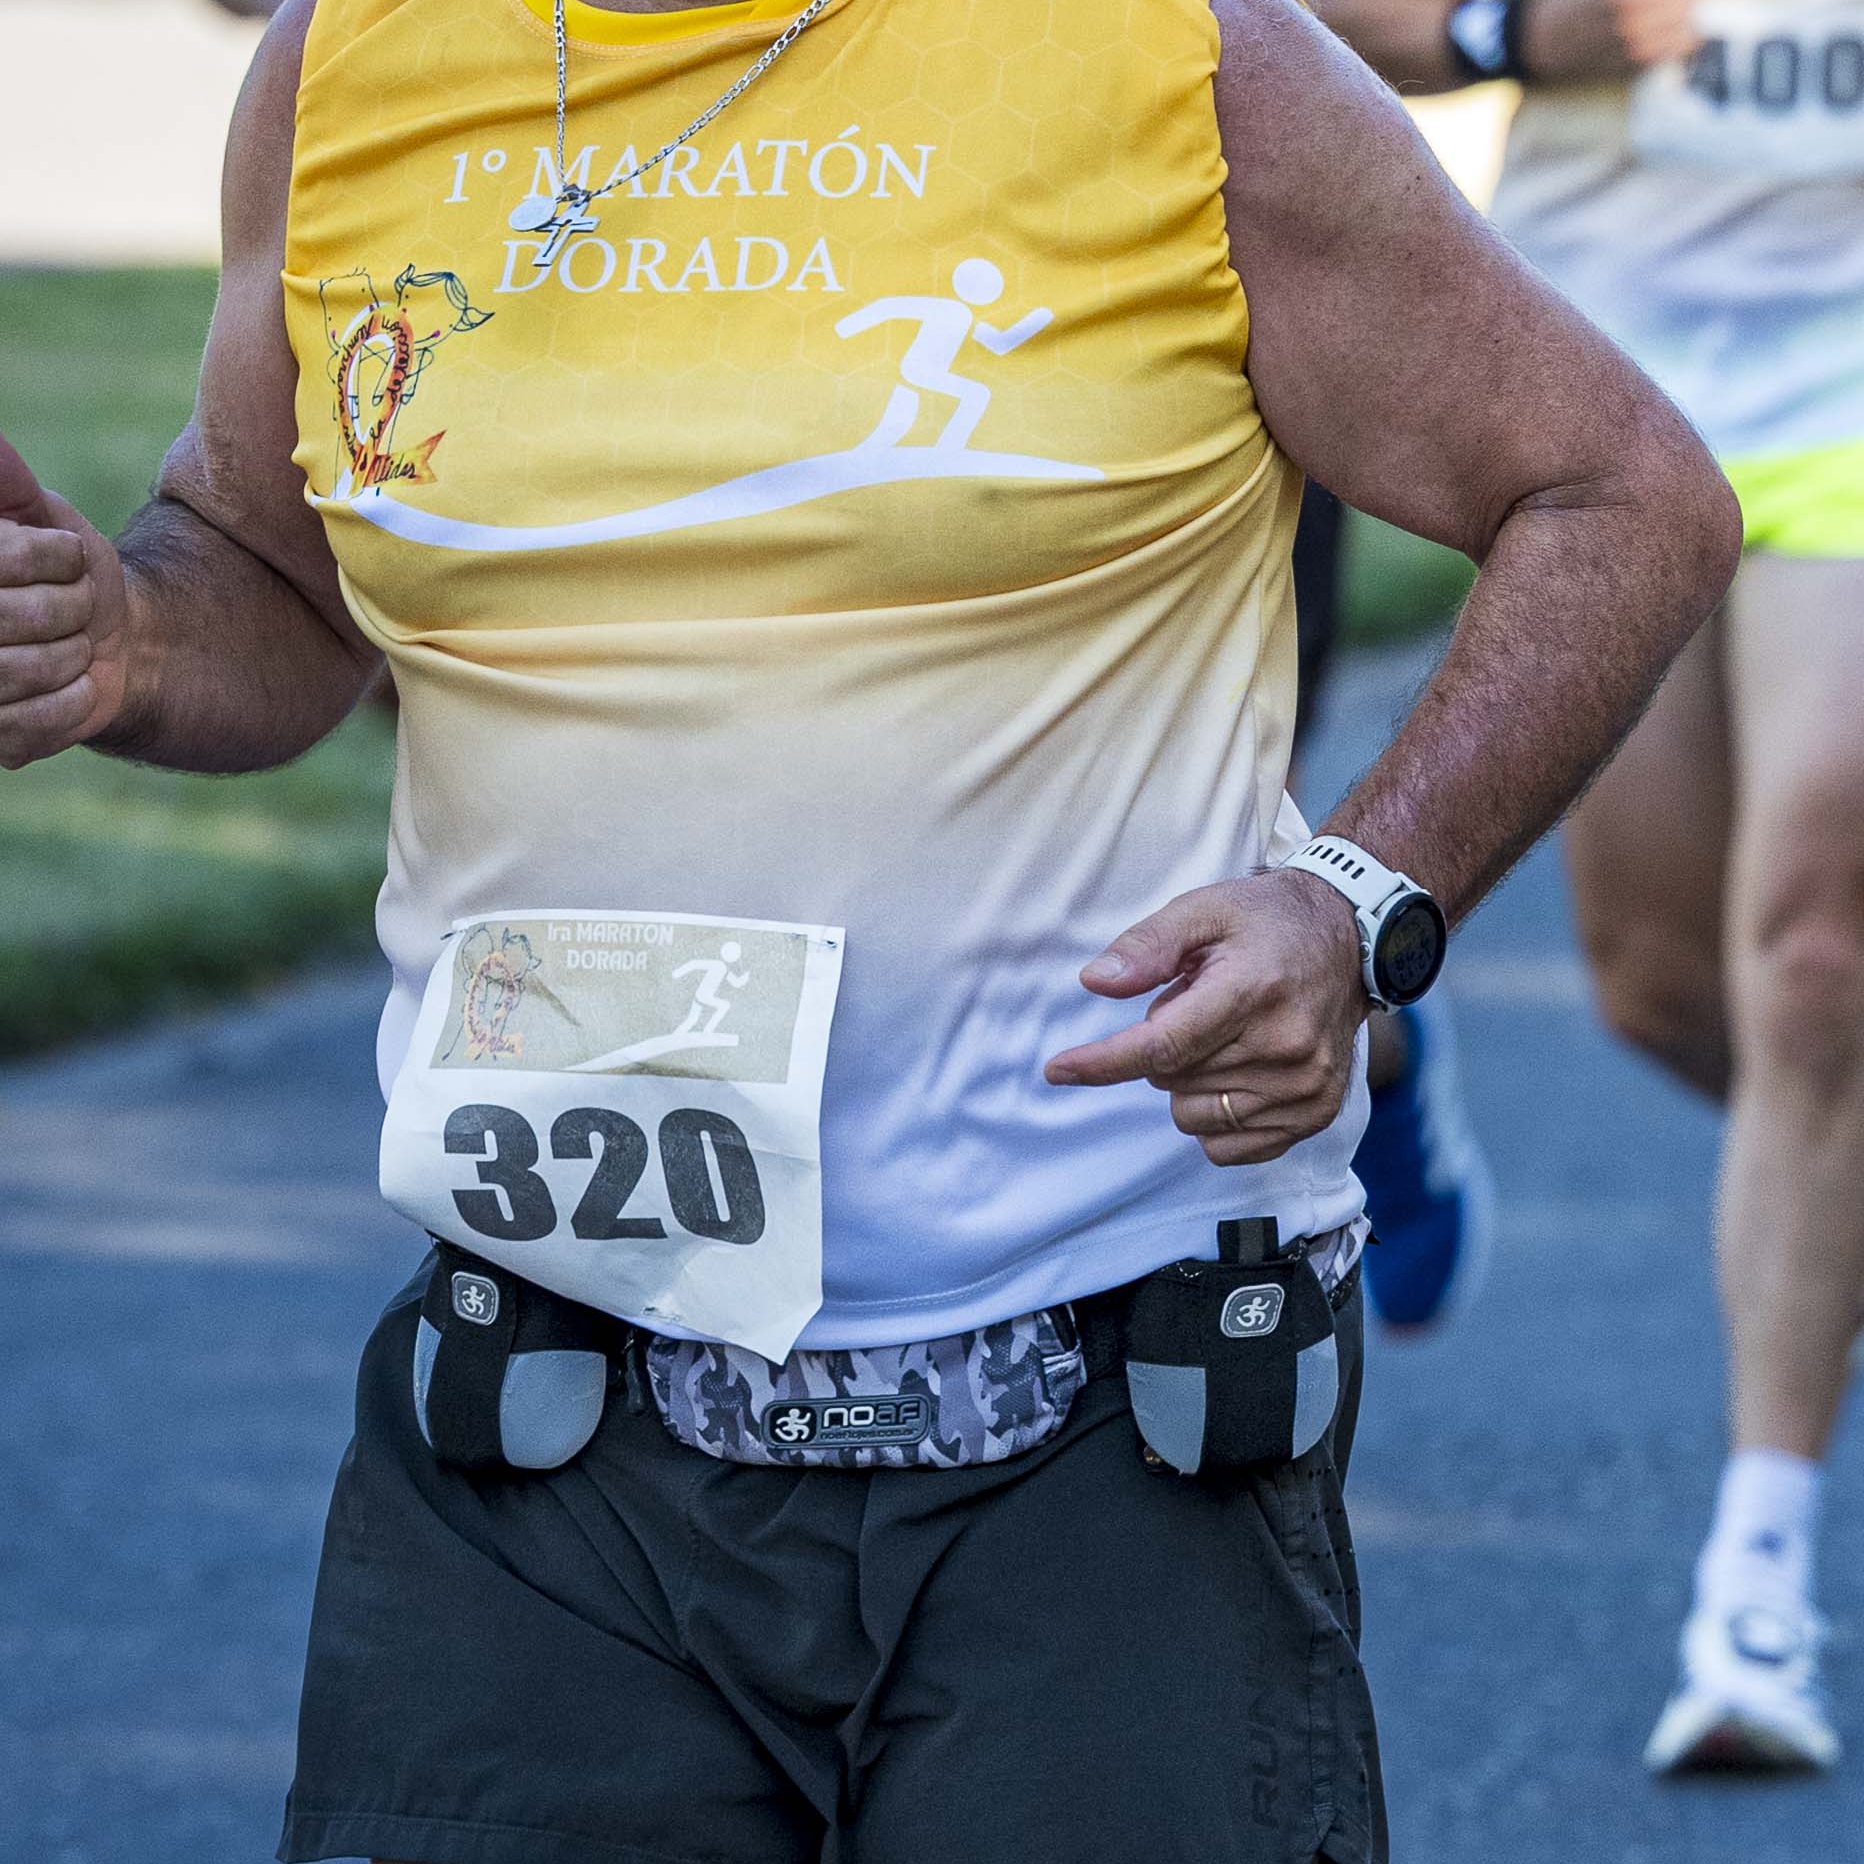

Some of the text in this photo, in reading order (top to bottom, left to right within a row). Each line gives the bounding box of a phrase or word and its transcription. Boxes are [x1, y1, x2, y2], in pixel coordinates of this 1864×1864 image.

[521, 124, 936, 200] MARATÓN
[493, 235, 846, 294] DORADA
[567, 948, 648, 970] DORADA
[443, 1103, 766, 1246] 320
